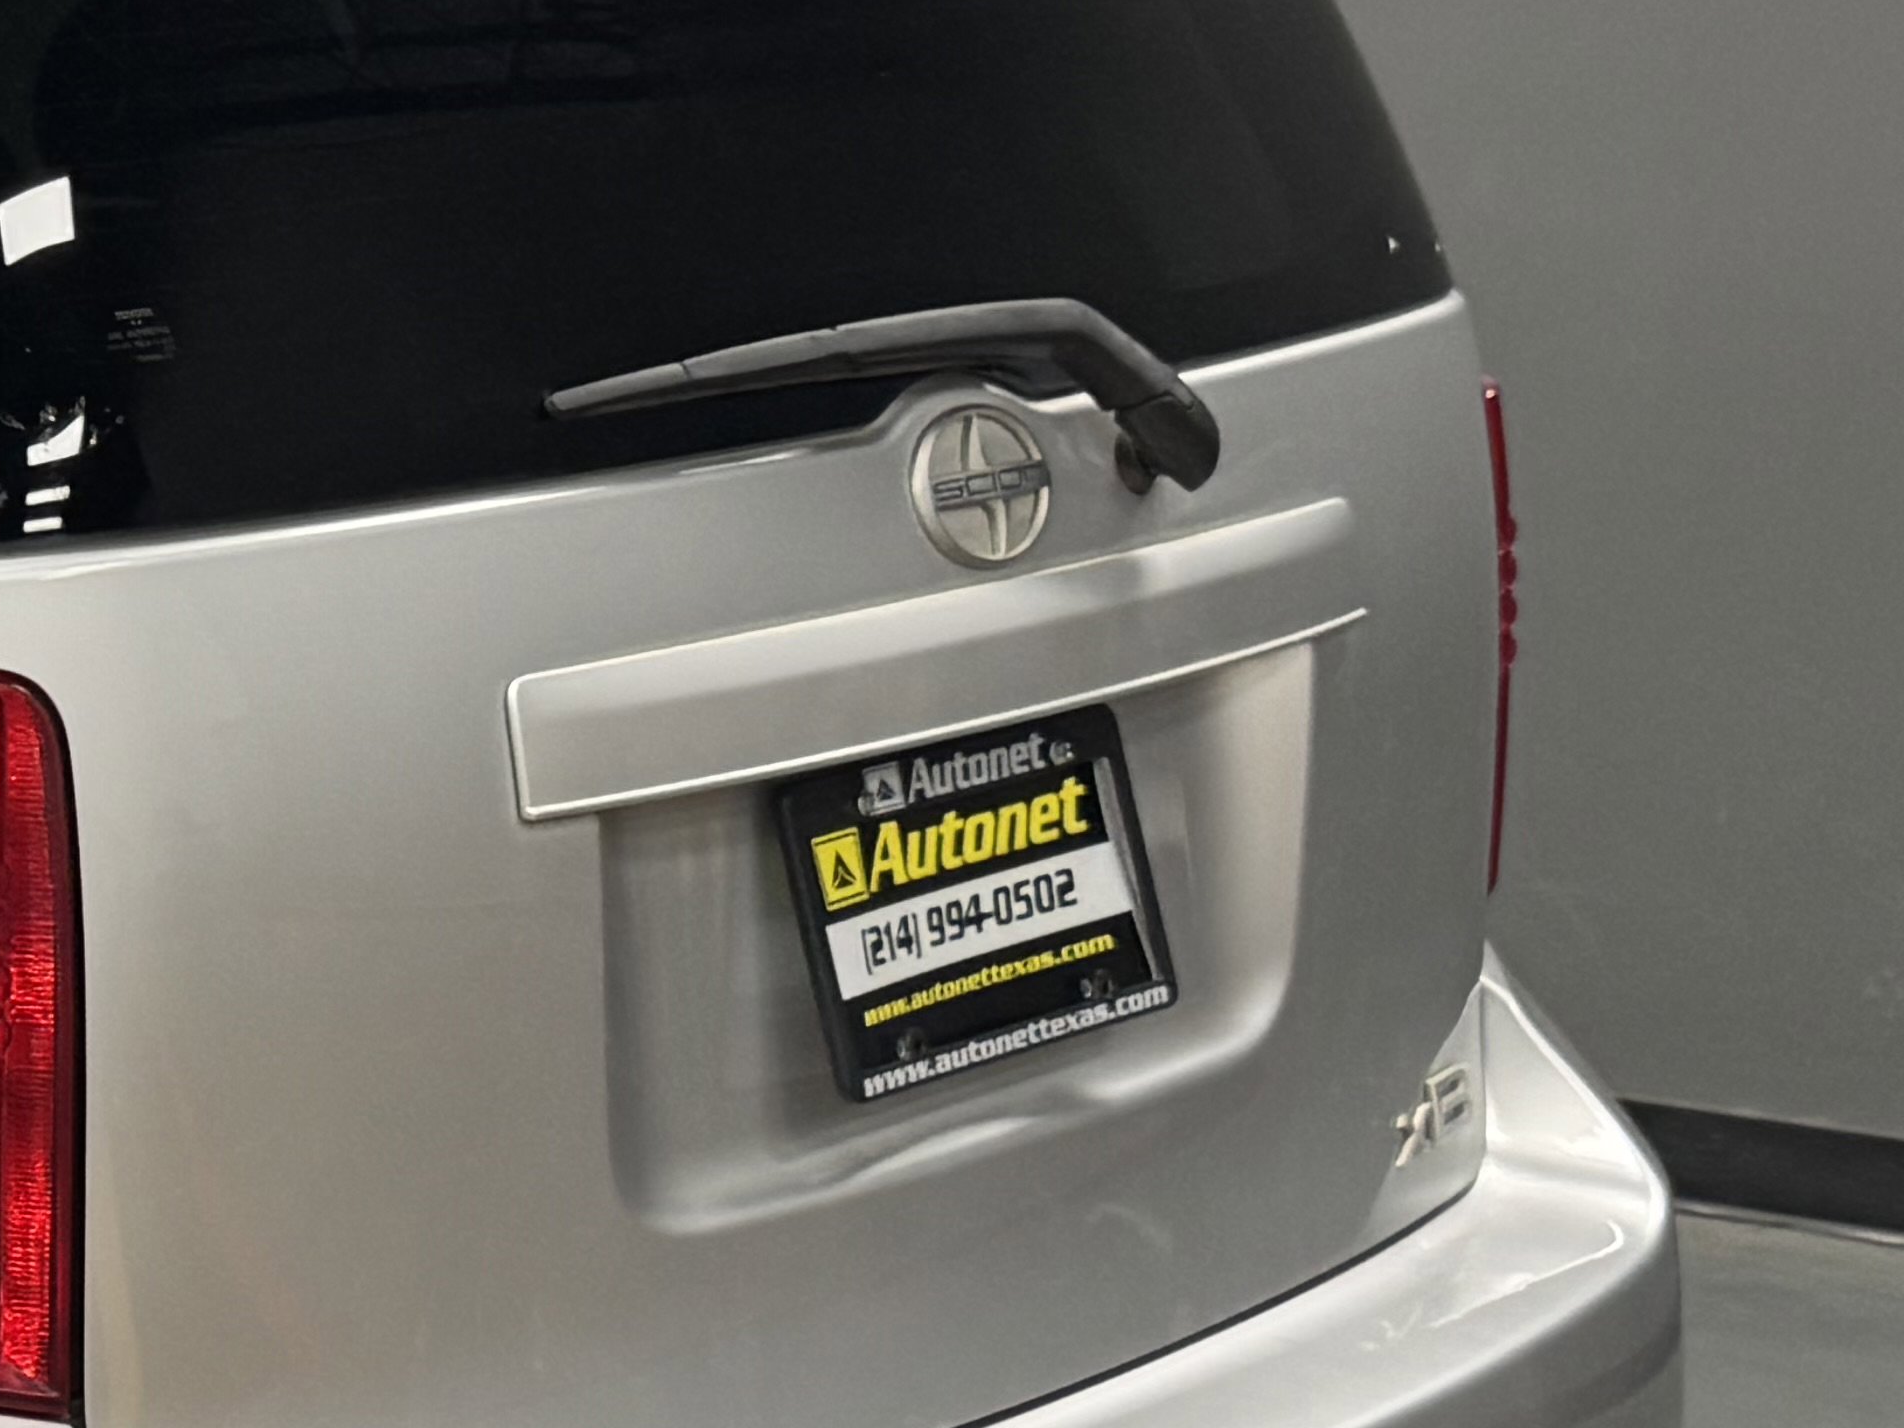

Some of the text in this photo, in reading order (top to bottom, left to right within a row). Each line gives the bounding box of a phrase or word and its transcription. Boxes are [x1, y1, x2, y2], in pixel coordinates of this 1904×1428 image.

[907, 732, 1047, 805] Autonet
[869, 775, 1089, 893] Autonet
[860, 867, 1078, 976] (214) 994-0502
[863, 933, 1118, 1028] www.autonettexas.com
[862, 984, 1170, 1098] www.autonettexas.com
